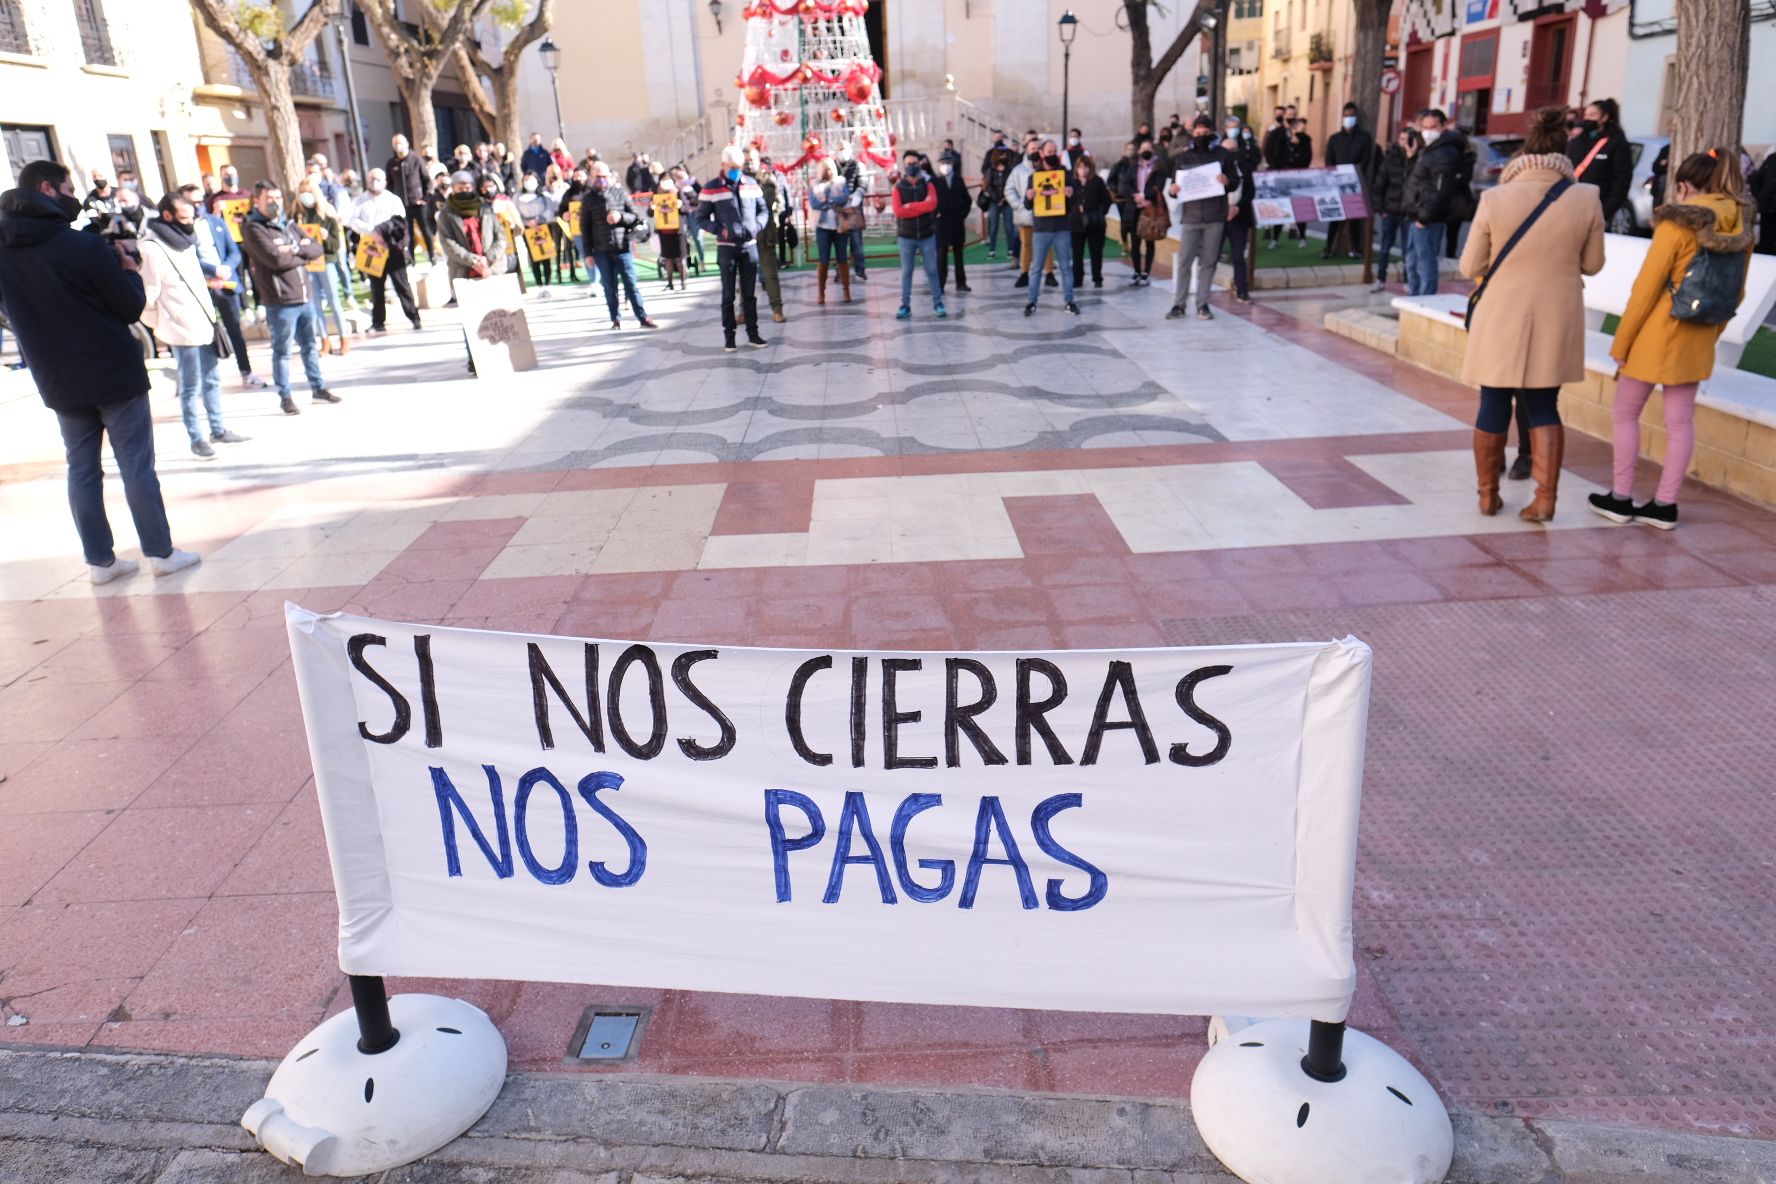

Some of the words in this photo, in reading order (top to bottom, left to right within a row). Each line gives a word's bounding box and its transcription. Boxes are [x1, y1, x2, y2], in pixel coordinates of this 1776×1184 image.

[347, 634, 443, 748] SI
[527, 643, 736, 760] NOS
[785, 655, 1234, 770] CIERRAS
[429, 764, 647, 887] NOS
[765, 789, 1108, 911] PAGAS
